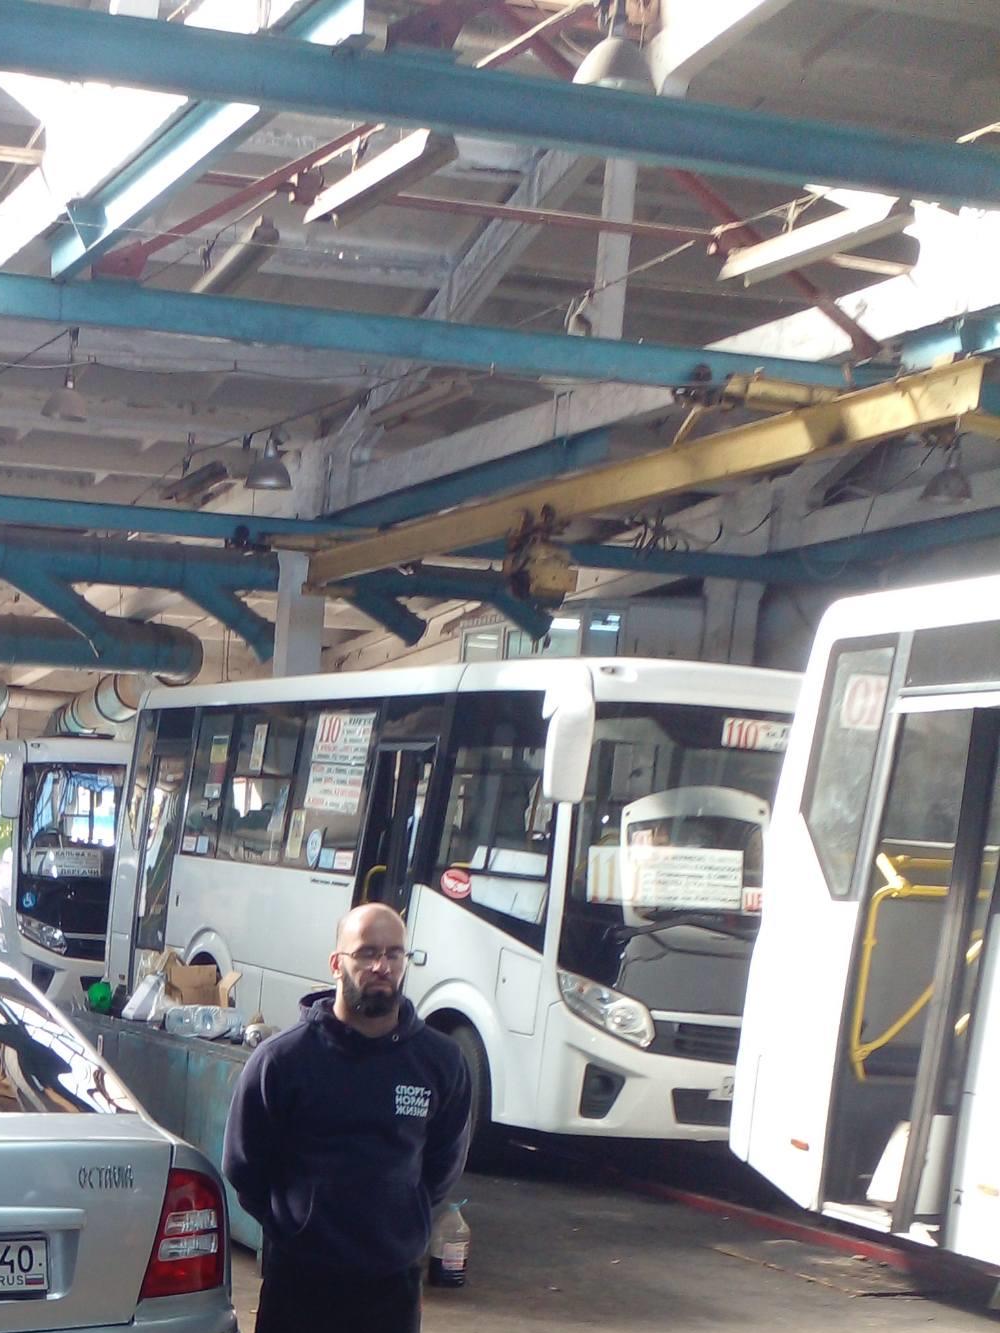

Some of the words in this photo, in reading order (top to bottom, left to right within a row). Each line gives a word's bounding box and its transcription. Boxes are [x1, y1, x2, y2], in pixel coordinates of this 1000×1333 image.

[319, 716, 341, 743] 110
[726, 719, 759, 750] 110
[79, 1165, 133, 1189] OCTAVIA
[0, 1244, 34, 1273] 40
